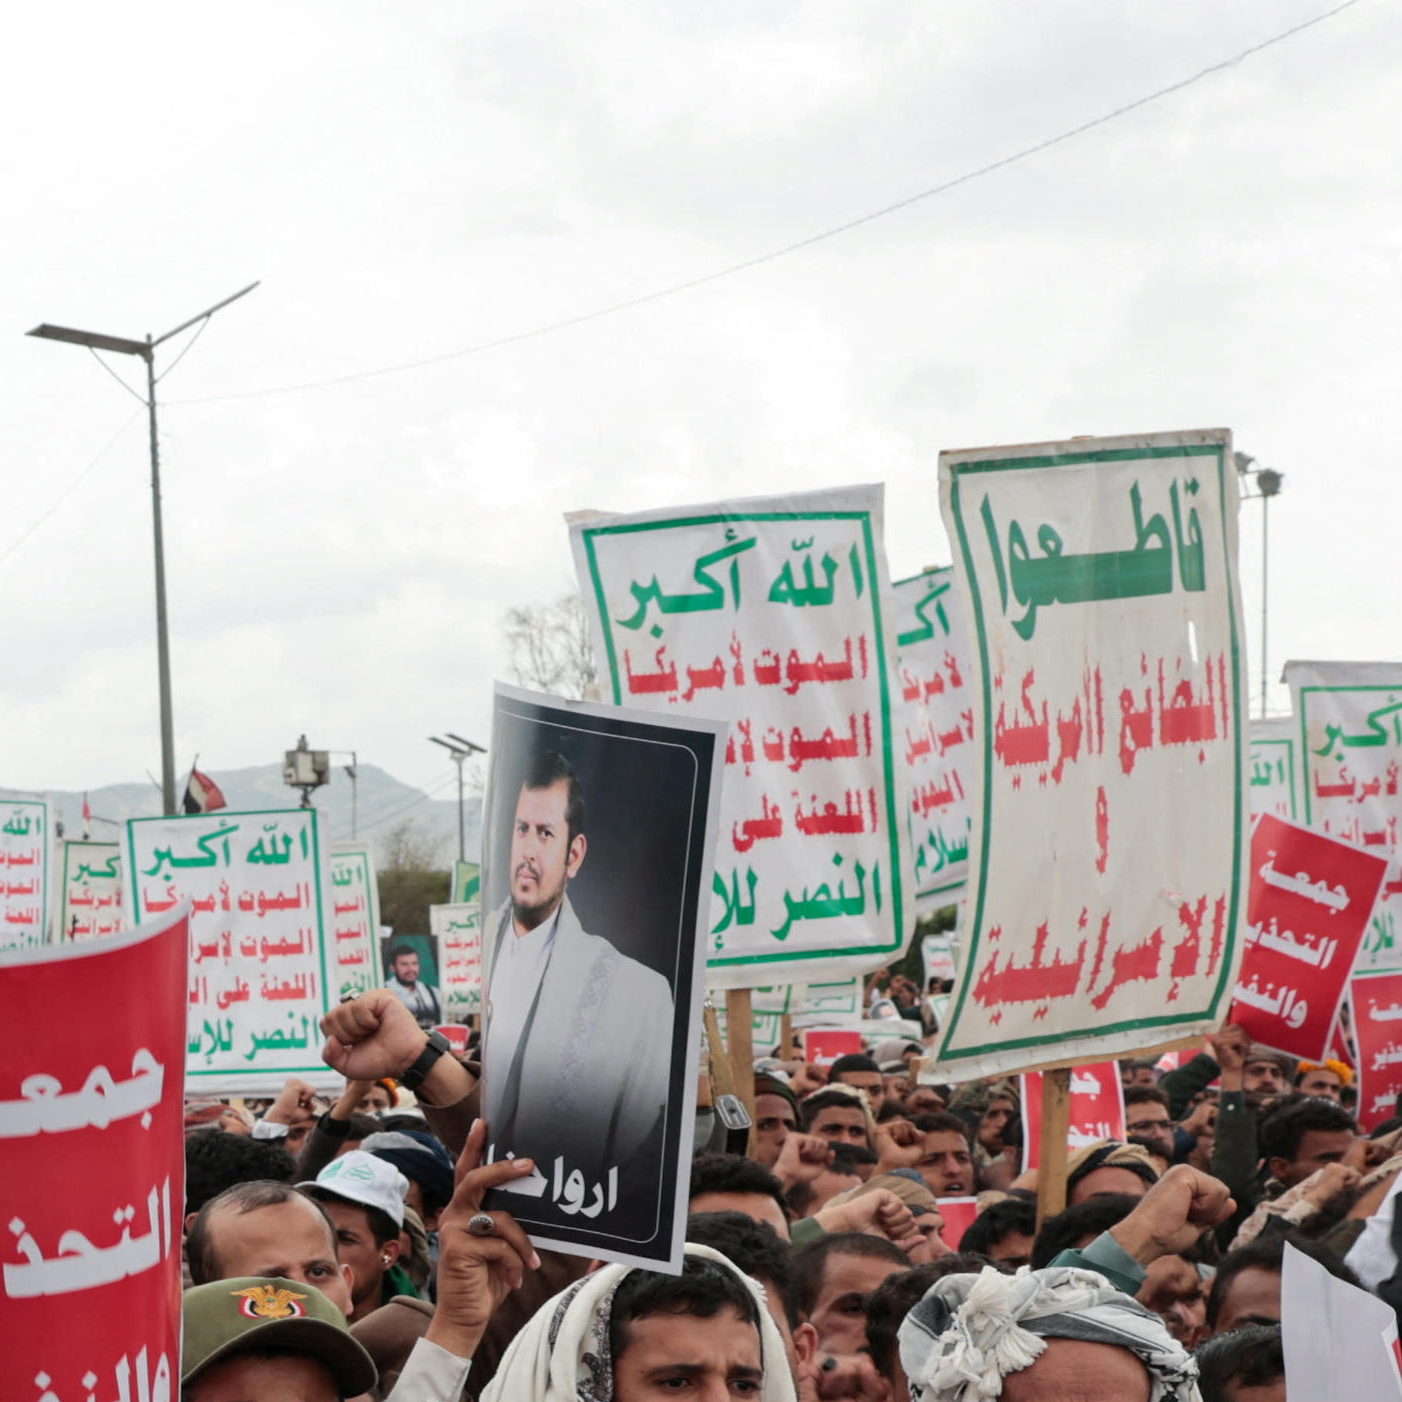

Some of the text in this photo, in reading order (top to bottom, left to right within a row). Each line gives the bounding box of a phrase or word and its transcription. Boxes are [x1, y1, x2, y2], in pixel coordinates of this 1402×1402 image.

[616, 528, 865, 639] الله أكبر
[979, 475, 1207, 642] قاطعوا
[624, 629, 871, 704] الموت لأمريكا
[762, 711, 873, 773] الموت
[1119, 650, 1229, 777] البضائع
[2, 808, 41, 836] الله
[141, 819, 310, 882] الله أكبر
[732, 786, 879, 855] اللعنة على
[1095, 785, 1110, 876] و
[70, 855, 122, 886] كبر
[238, 881, 311, 917] الموت
[332, 862, 363, 887] الل
[769, 851, 883, 942] النصر
[1259, 850, 1351, 916] جمعة
[240, 928, 313, 963] الموت
[972, 891, 1228, 1027] الإسرائيلية
[1243, 914, 1339, 971] التحذي
[216, 972, 316, 1010] اللعنة على
[1232, 973, 1308, 1030] والنفي
[244, 1011, 320, 1062] النصر
